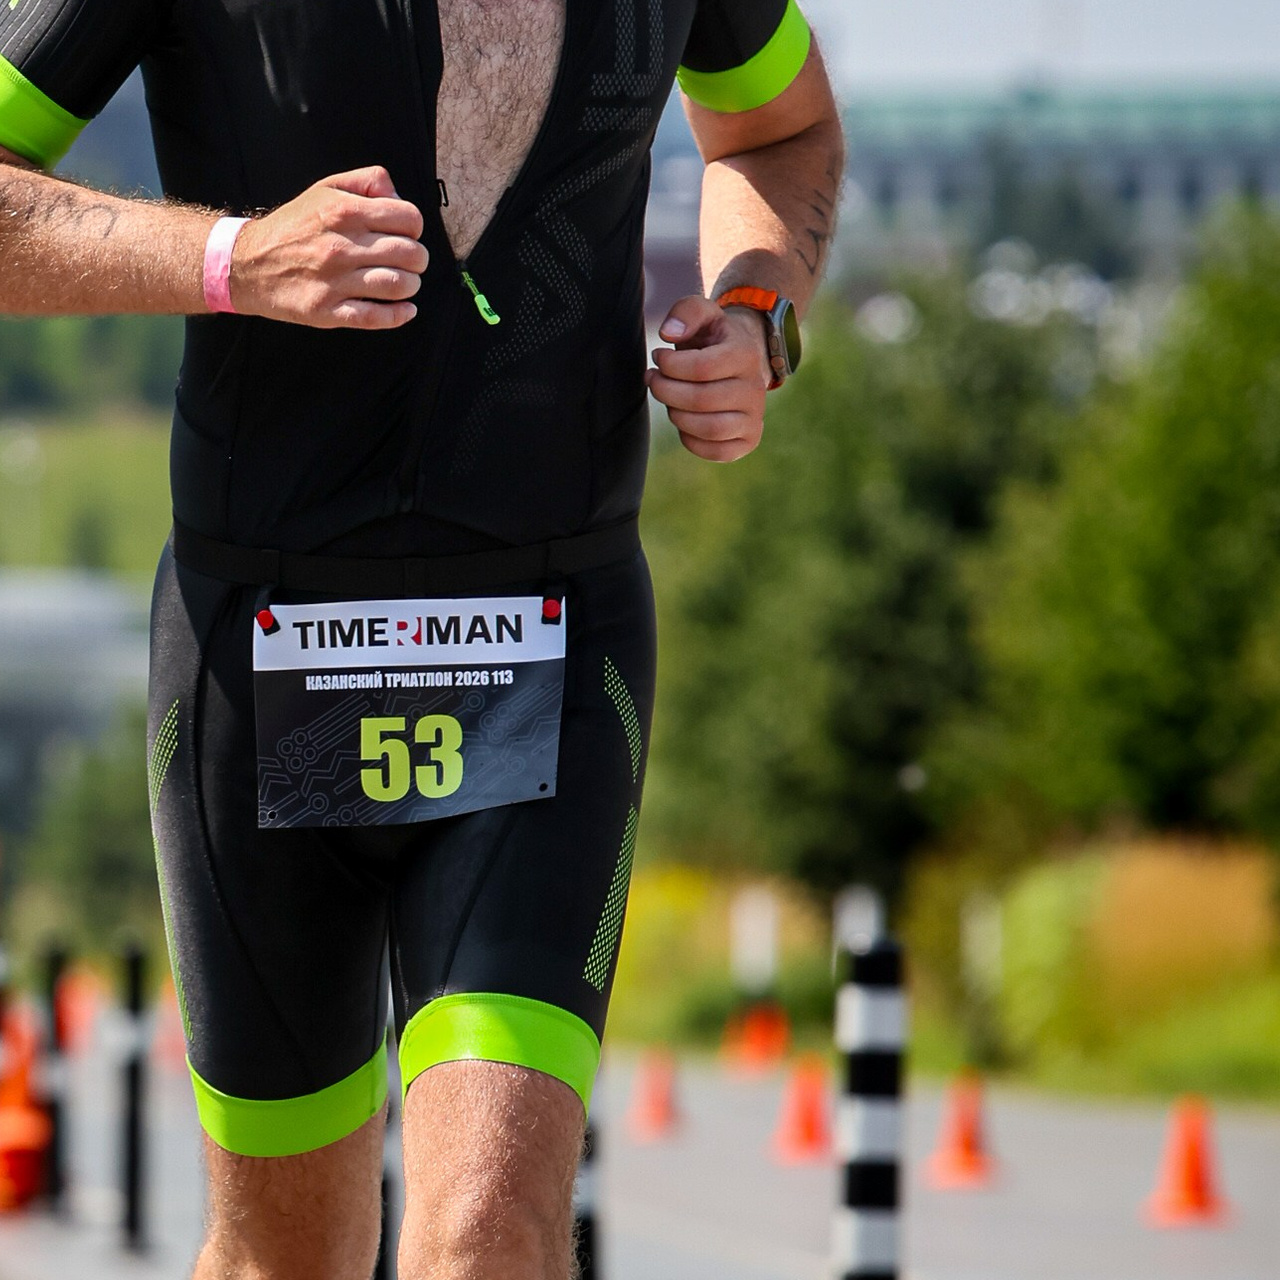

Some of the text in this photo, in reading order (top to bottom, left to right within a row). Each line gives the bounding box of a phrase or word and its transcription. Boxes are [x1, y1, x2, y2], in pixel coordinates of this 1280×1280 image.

[305, 669, 515, 691] КАЗАНСКИЙ ТРИАТЛОН 2026 113
[360, 714, 464, 802] 53
